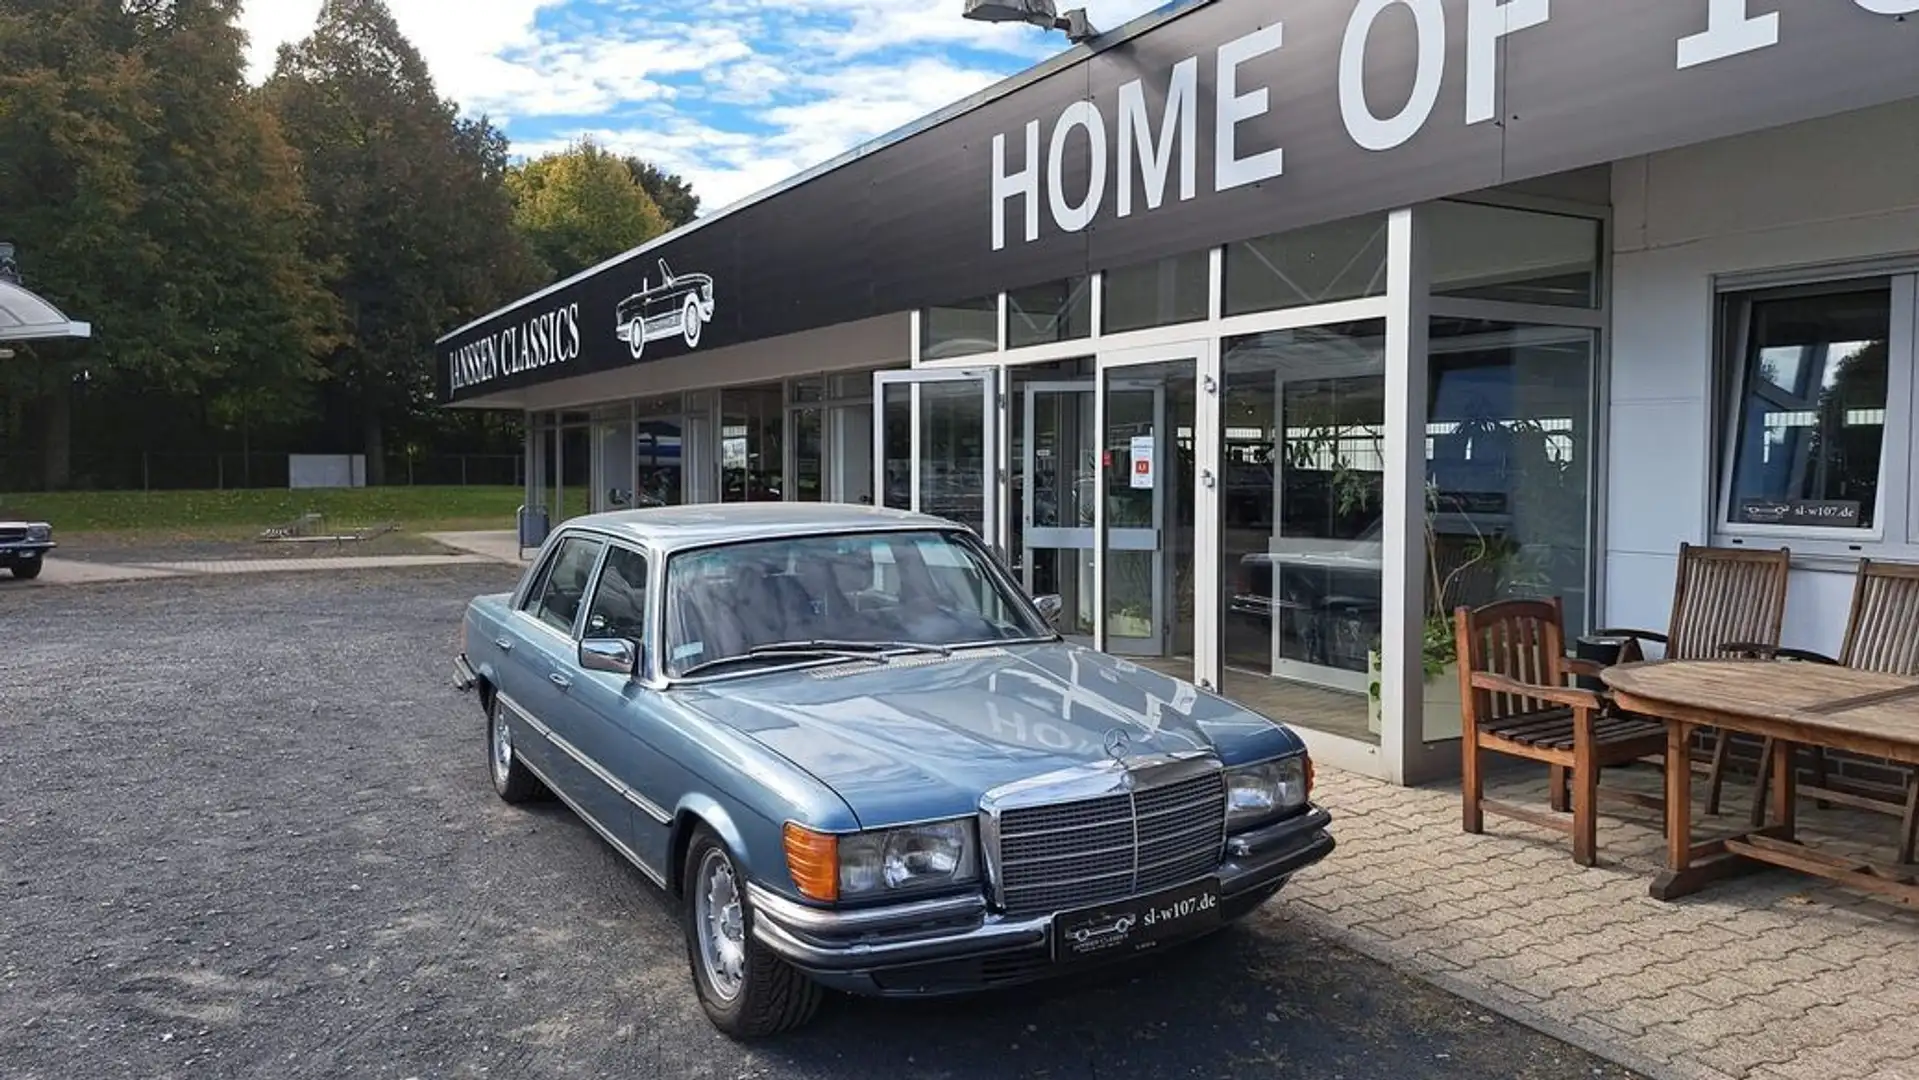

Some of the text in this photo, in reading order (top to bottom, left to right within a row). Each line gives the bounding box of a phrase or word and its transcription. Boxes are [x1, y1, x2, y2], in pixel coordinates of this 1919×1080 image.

[992, 0, 1549, 251] HOME OF
[449, 302, 580, 399] JANSSEN CLASSICS
[1794, 505, 1855, 518] sl-w107.de
[1143, 893, 1217, 927] sl-w107.de
